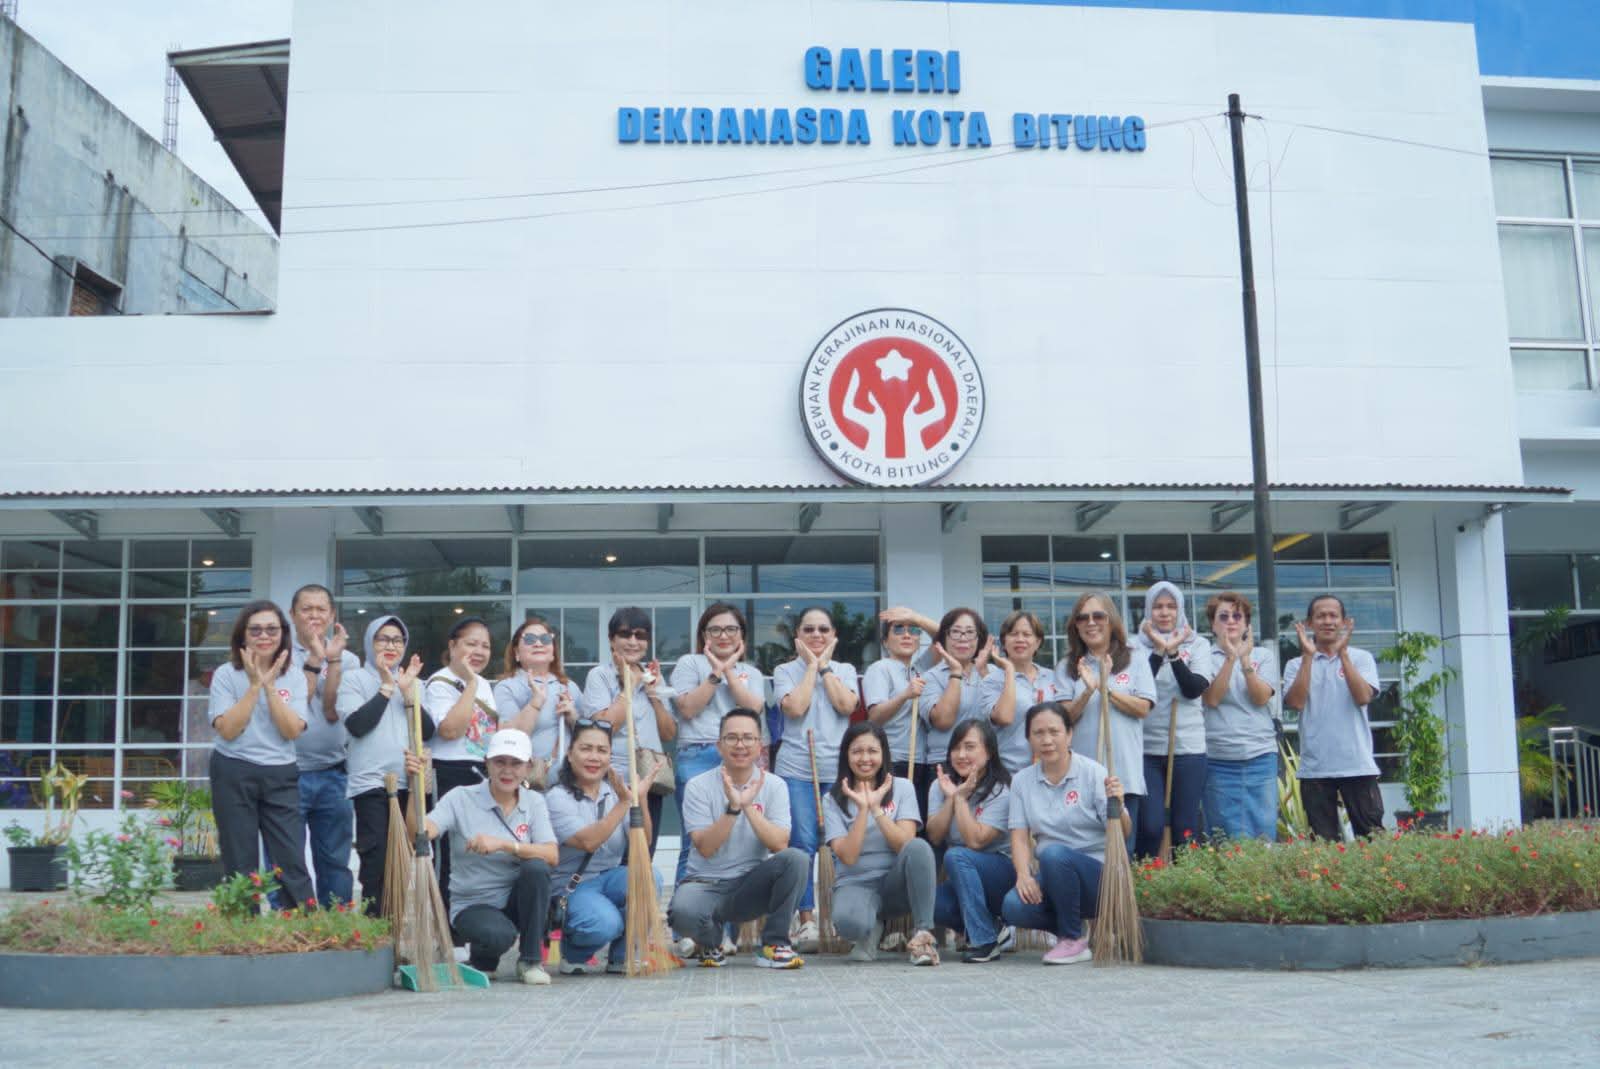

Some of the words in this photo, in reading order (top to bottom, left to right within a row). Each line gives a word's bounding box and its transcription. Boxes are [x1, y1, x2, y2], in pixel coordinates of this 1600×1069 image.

[804, 46, 961, 94] GALERI
[617, 107, 871, 145] DEKRANASDA
[892, 109, 992, 147] KOTA
[1013, 113, 1146, 152] BITUNG
[812, 318, 890, 377] KERAJINAN
[895, 318, 968, 371] NASIONAL
[809, 381, 832, 441] DEWAN
[958, 372, 978, 441] DAERAH
[840, 451, 882, 477] KOTA
[887, 451, 950, 478] BITUNG
